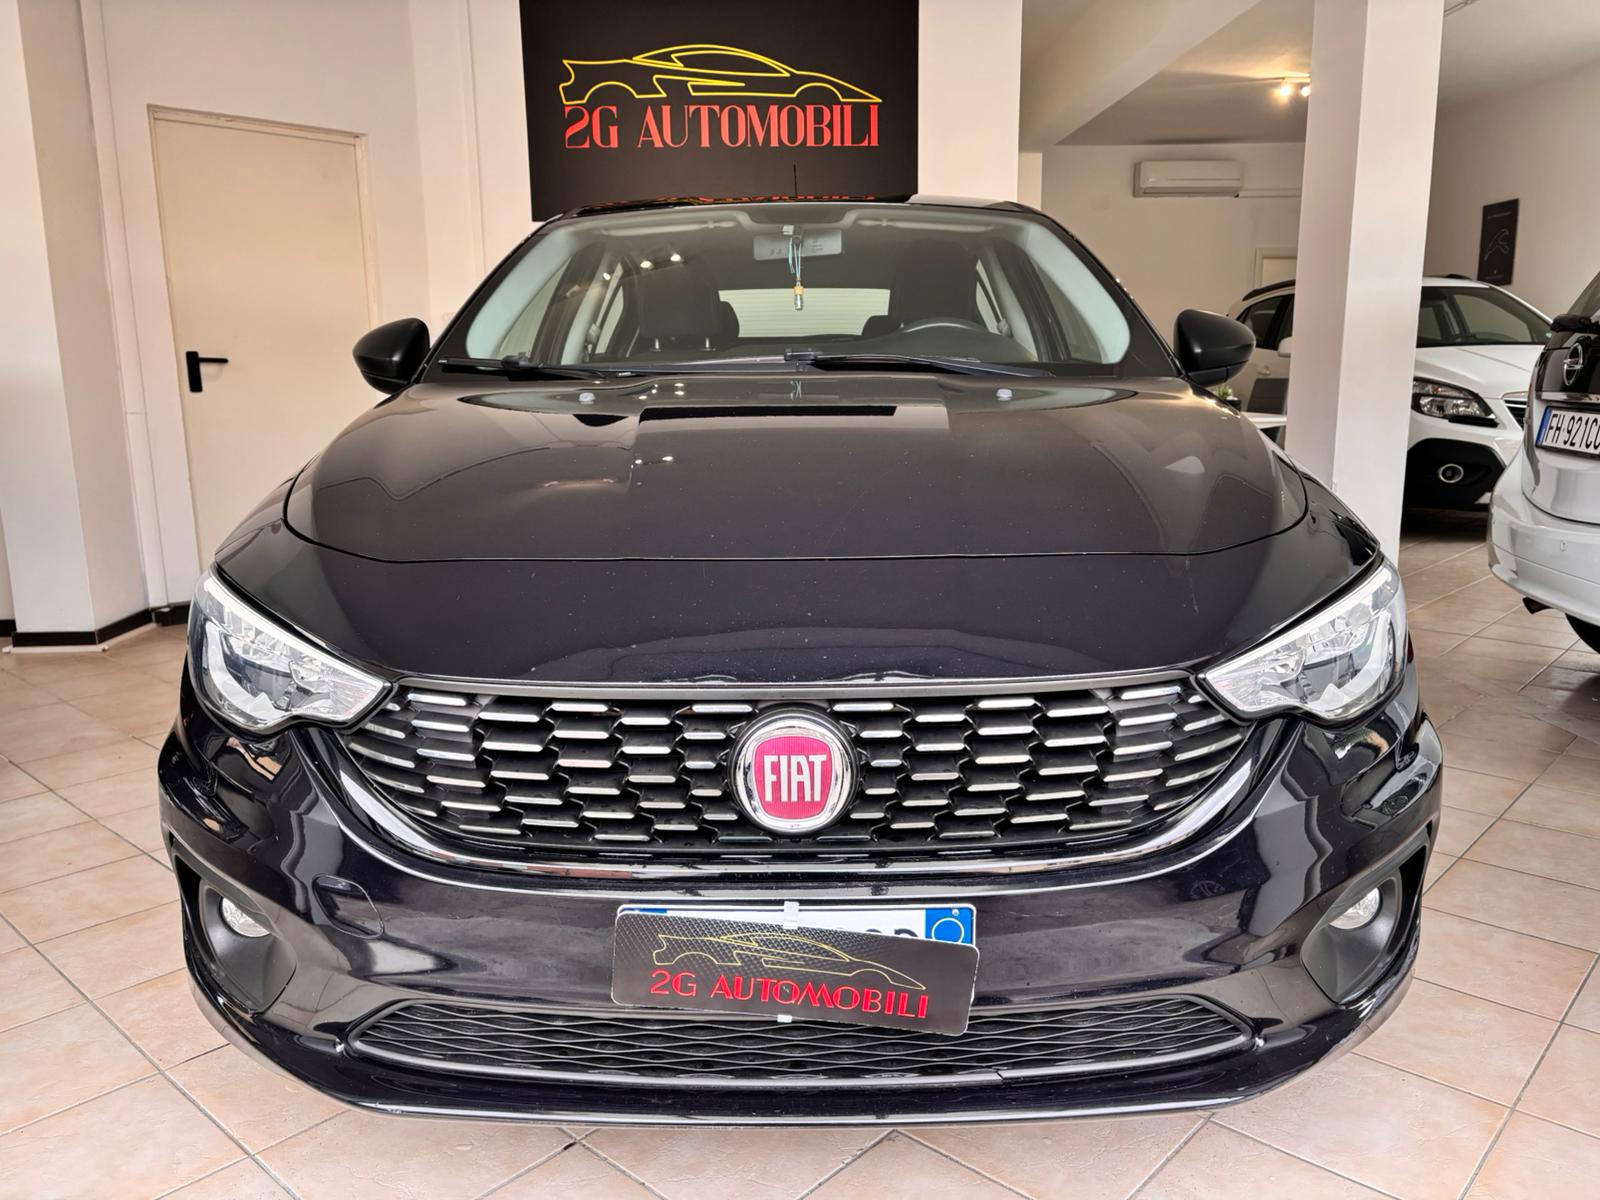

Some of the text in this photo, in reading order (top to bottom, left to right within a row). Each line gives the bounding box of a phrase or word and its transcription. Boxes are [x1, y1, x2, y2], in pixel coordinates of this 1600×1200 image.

[564, 105, 880, 149] 2G AUTOMOBILI
[763, 755, 827, 802] FIAT
[650, 969, 929, 1019] 2G AUTOMOBILI
